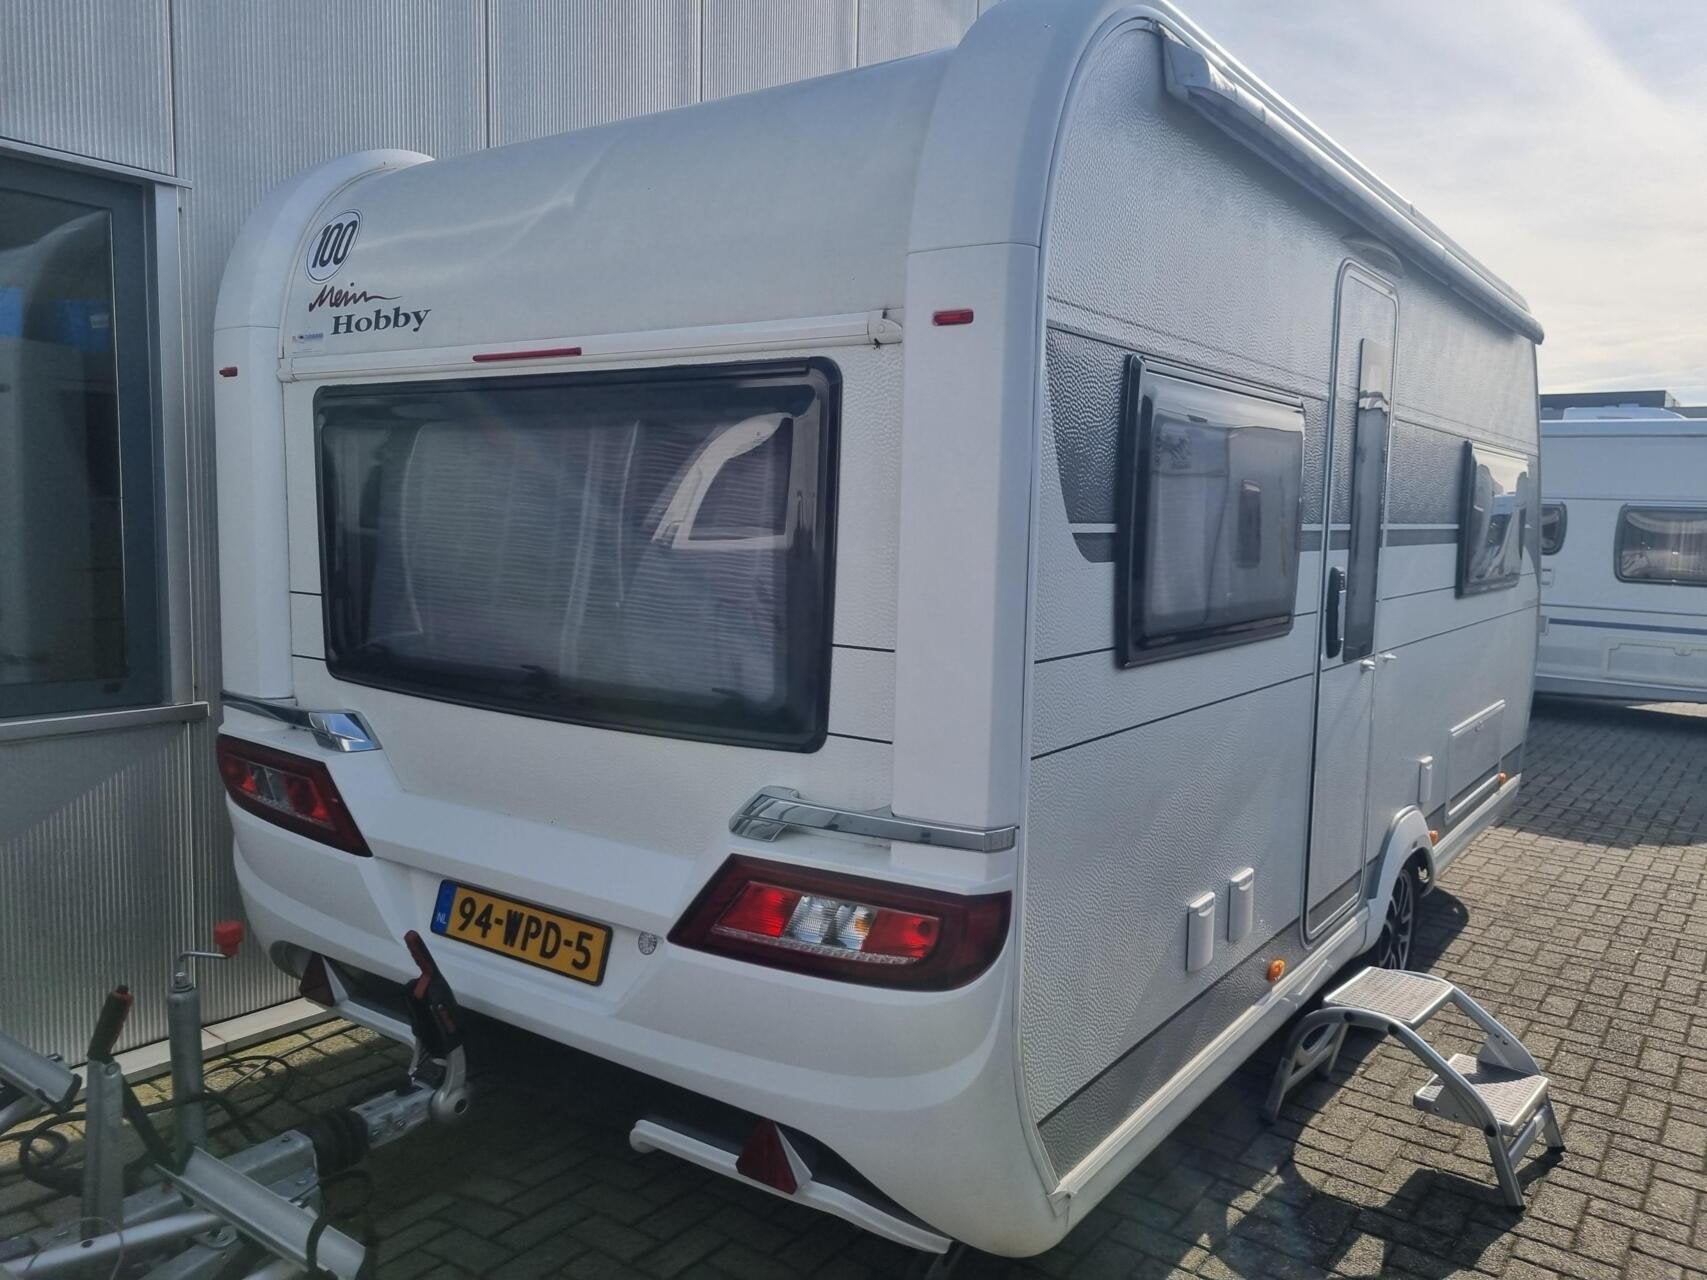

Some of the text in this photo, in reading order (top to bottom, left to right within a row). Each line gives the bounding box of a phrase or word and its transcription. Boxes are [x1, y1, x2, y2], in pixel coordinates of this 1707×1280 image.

[312, 220, 358, 268] 100
[309, 282, 402, 312] Mein
[331, 306, 432, 335] Hobby
[437, 911, 447, 924] NL
[459, 896, 593, 970] 94-WPD-5
